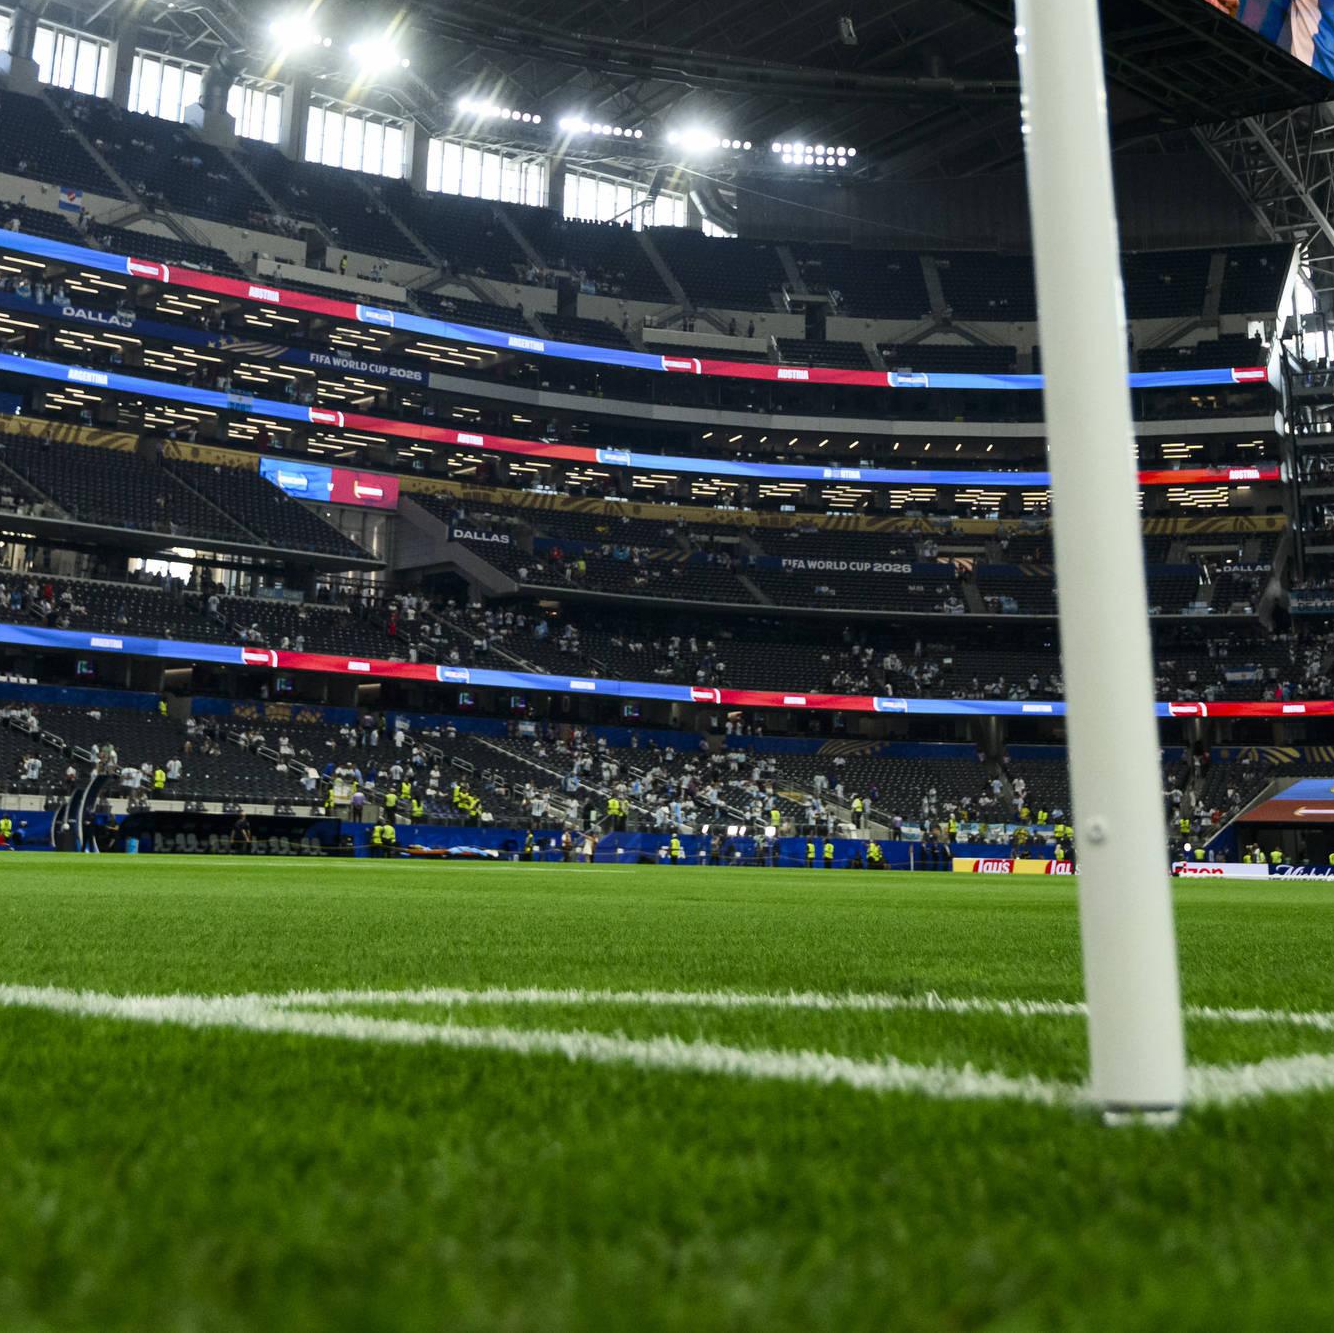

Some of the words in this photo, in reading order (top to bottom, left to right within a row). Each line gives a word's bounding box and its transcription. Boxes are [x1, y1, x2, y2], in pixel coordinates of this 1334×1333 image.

[309, 353, 332, 366] FIFA
[332, 356, 368, 372] WORLD
[369, 361, 388, 375] CUP
[389, 368, 423, 381] 2026
[68, 368, 108, 386] ARGENTINA
[453, 529, 510, 544] DALLAS
[782, 558, 806, 569] FIFA
[807, 560, 848, 571] WORLD
[849, 561, 871, 571] CUP
[873, 562, 912, 574] 2026
